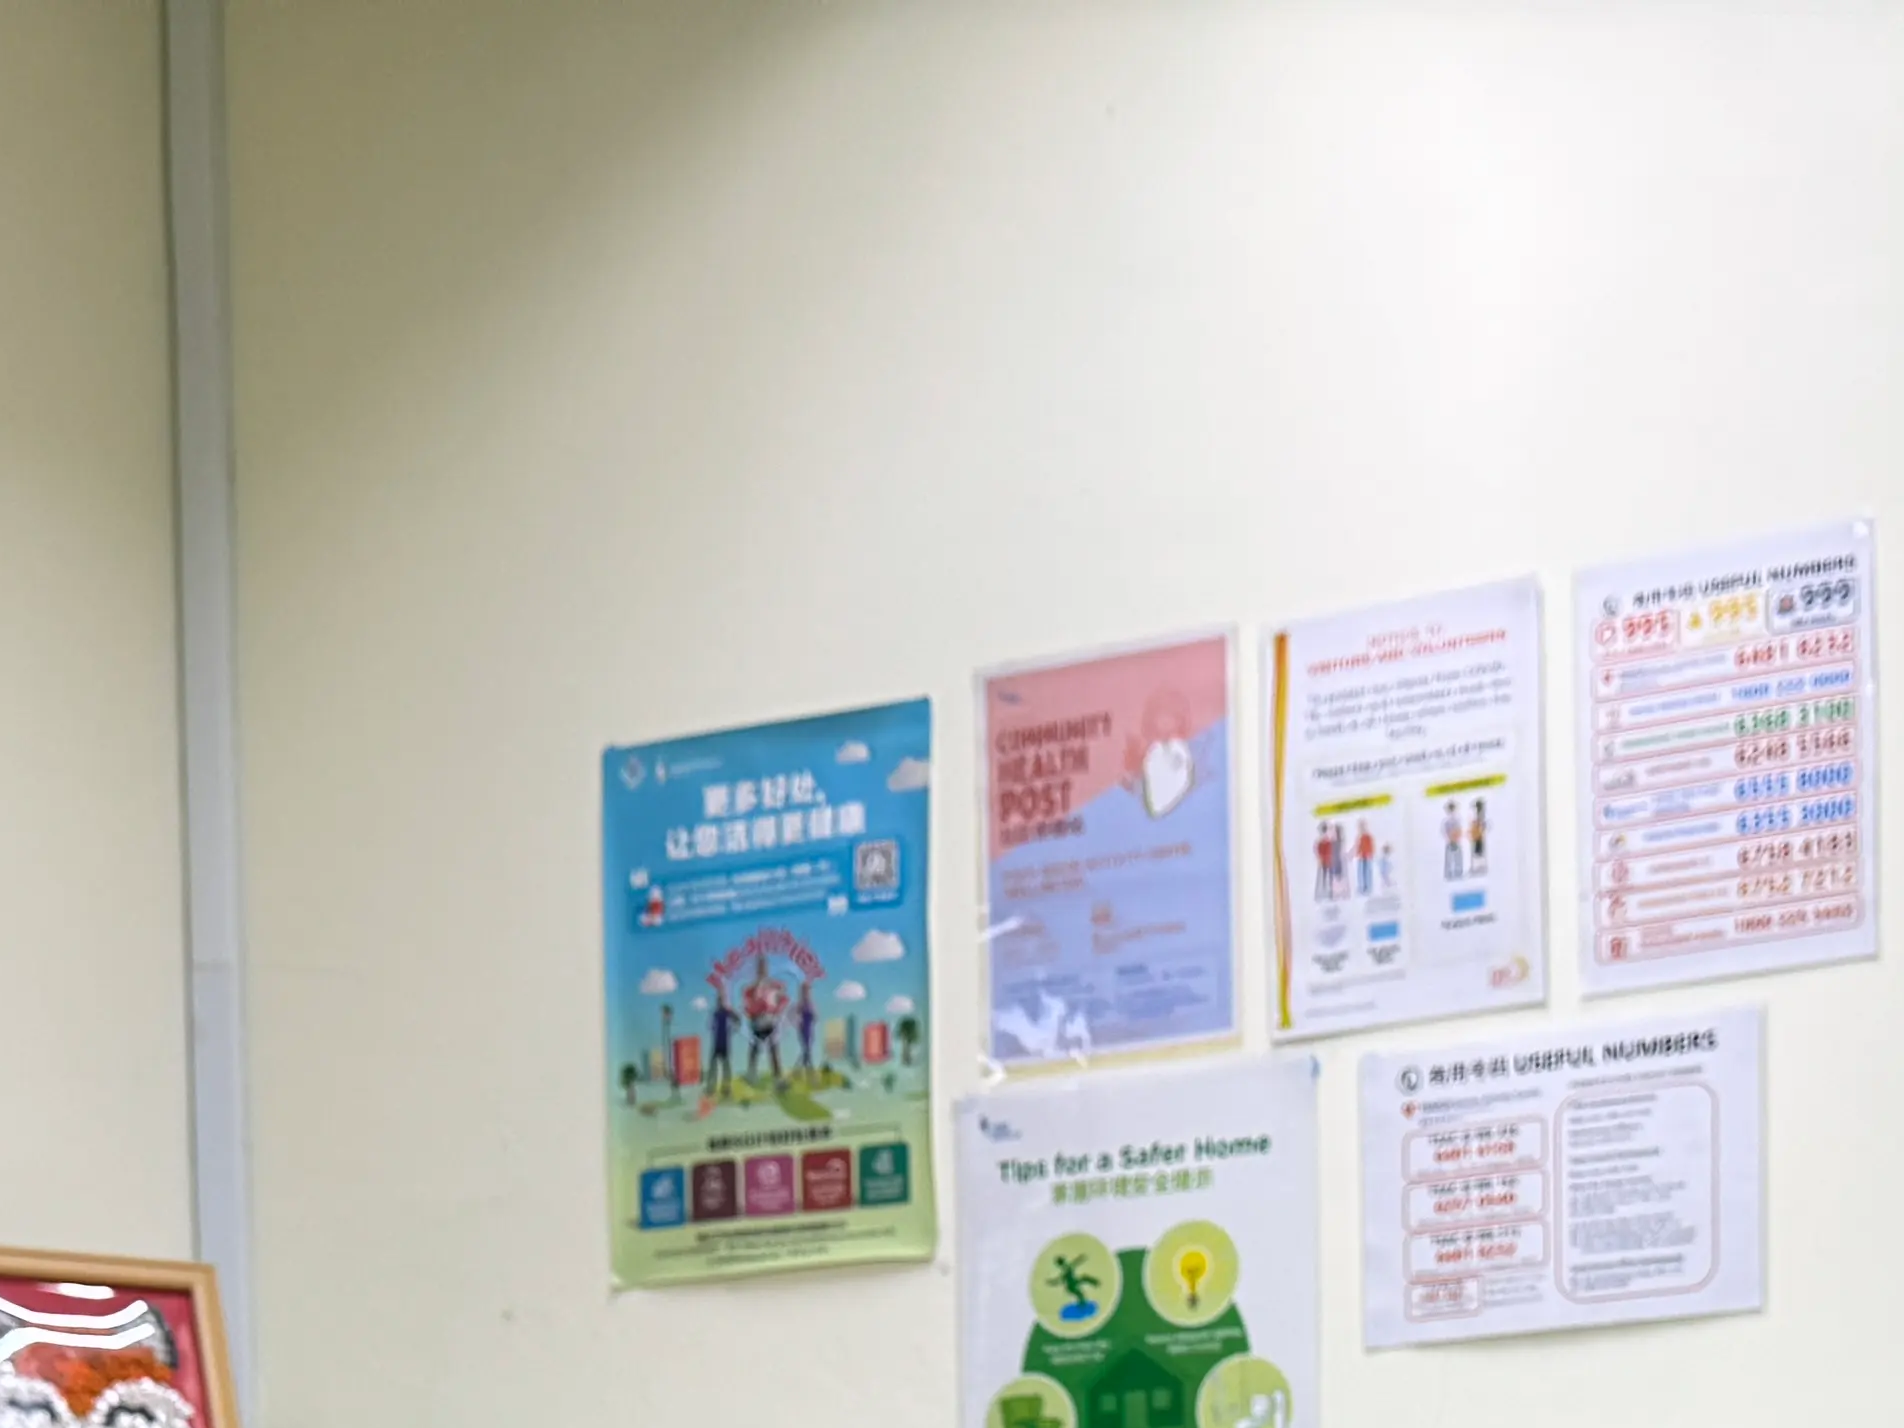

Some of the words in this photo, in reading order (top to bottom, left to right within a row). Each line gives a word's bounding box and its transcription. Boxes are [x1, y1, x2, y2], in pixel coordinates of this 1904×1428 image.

[996, 711, 1113, 753] COMMUNITY
[998, 744, 1089, 784] HEALTH
[999, 780, 1073, 823] POST
[1513, 1043, 1595, 1075] USEFUL
[1602, 1029, 1719, 1065] NUMBERS
[997, 1158, 1048, 1184] Tips
[1053, 1151, 1092, 1176] for
[1096, 1153, 1113, 1173] a
[1118, 1140, 1186, 1168] Safer
[1194, 1133, 1273, 1162] Home
